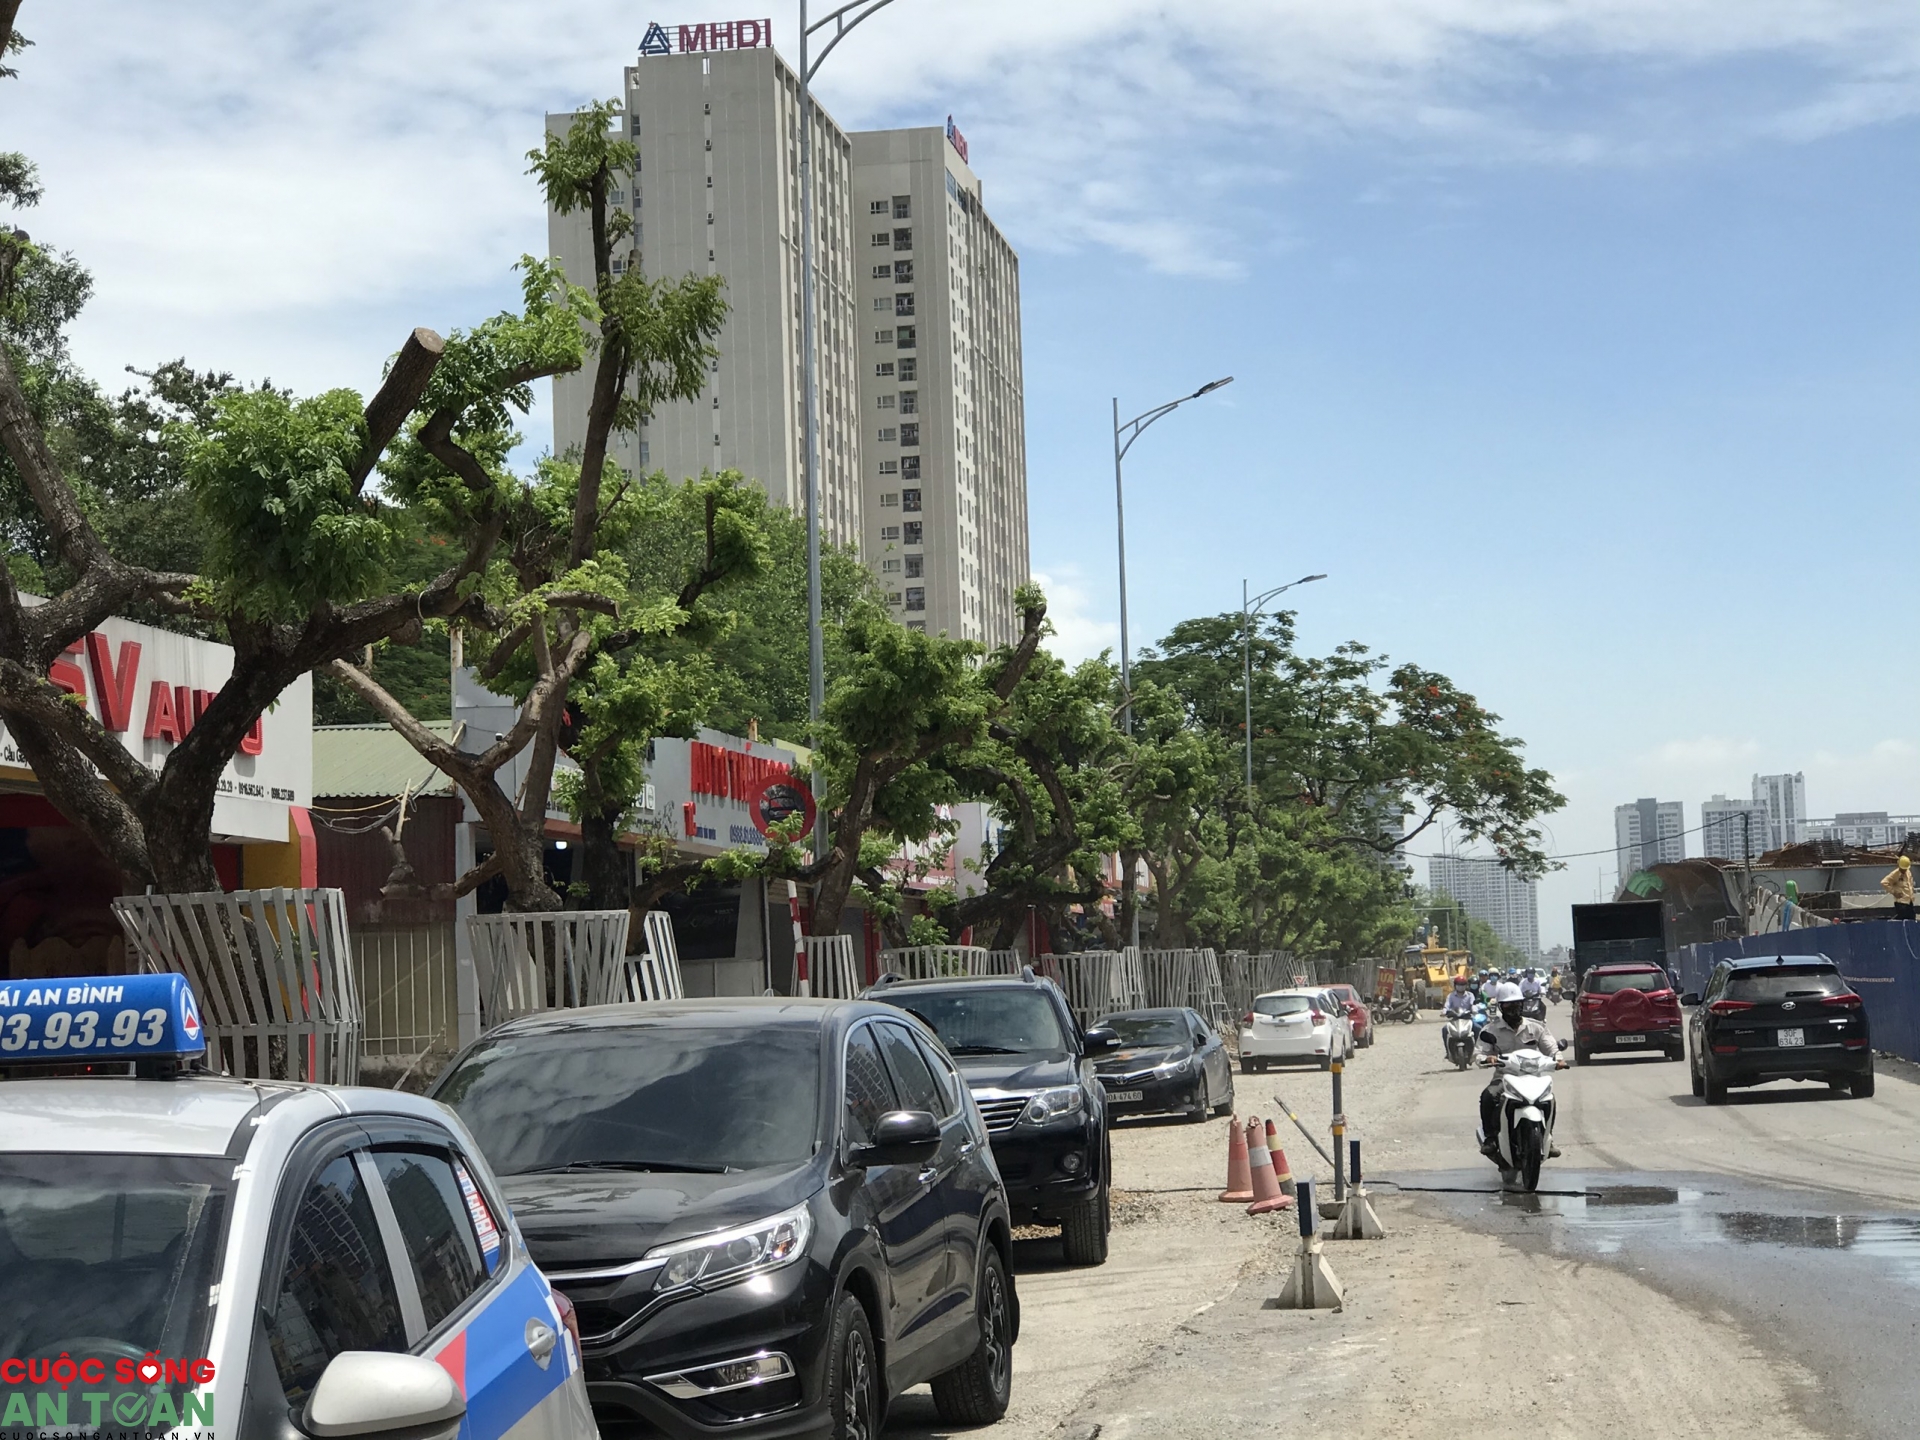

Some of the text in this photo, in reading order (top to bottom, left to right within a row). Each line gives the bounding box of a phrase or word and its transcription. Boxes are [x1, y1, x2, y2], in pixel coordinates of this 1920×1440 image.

[678, 18, 772, 51] MHDI
[691, 740, 728, 798] AUTO
[24, 987, 61, 1006] AN
[66, 983, 124, 1005] BÌNH
[0, 1008, 167, 1051] 3.93.93
